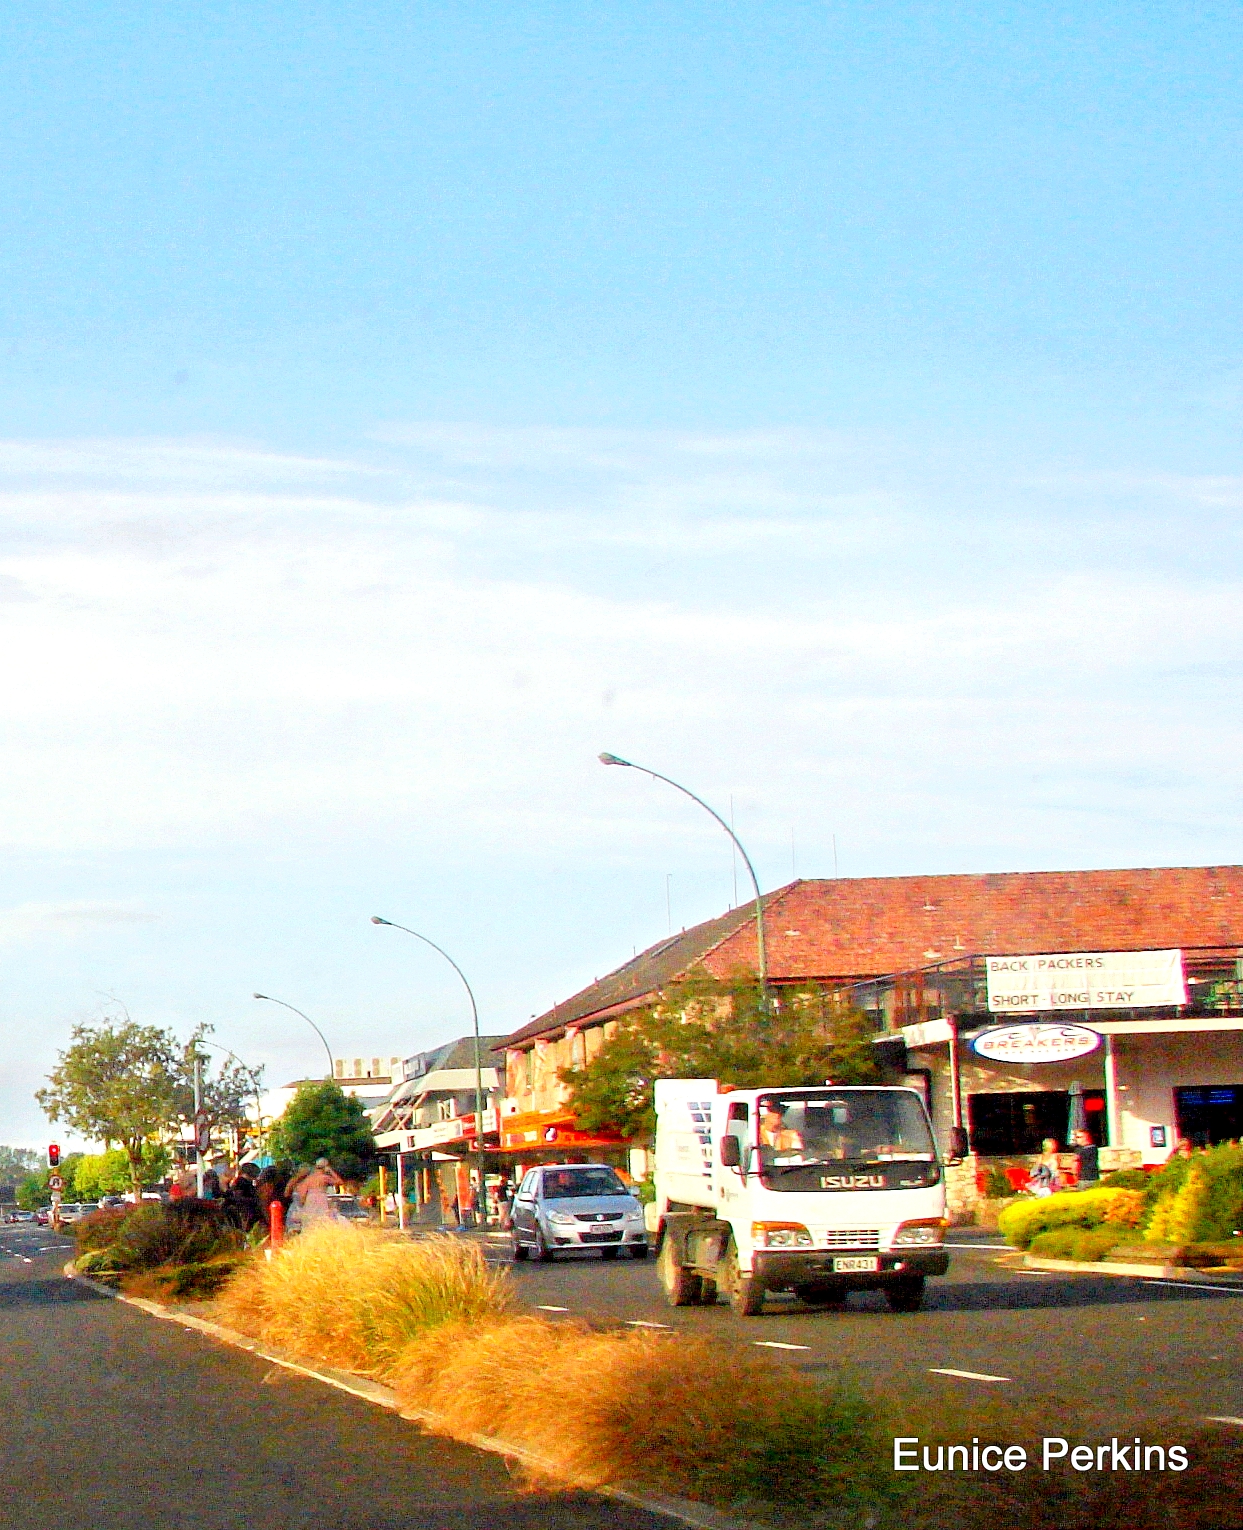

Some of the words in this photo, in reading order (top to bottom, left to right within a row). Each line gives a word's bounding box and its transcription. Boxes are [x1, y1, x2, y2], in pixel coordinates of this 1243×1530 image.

[990, 960, 1028, 972] BACK
[1037, 957, 1104, 970] PACKERS
[992, 994, 1039, 1006] SHORT
[1050, 992, 1089, 1005] LONG
[1096, 991, 1135, 1003] STAY
[983, 1036, 1089, 1050] BREAKERS
[820, 1175, 884, 1189] ISUZU
